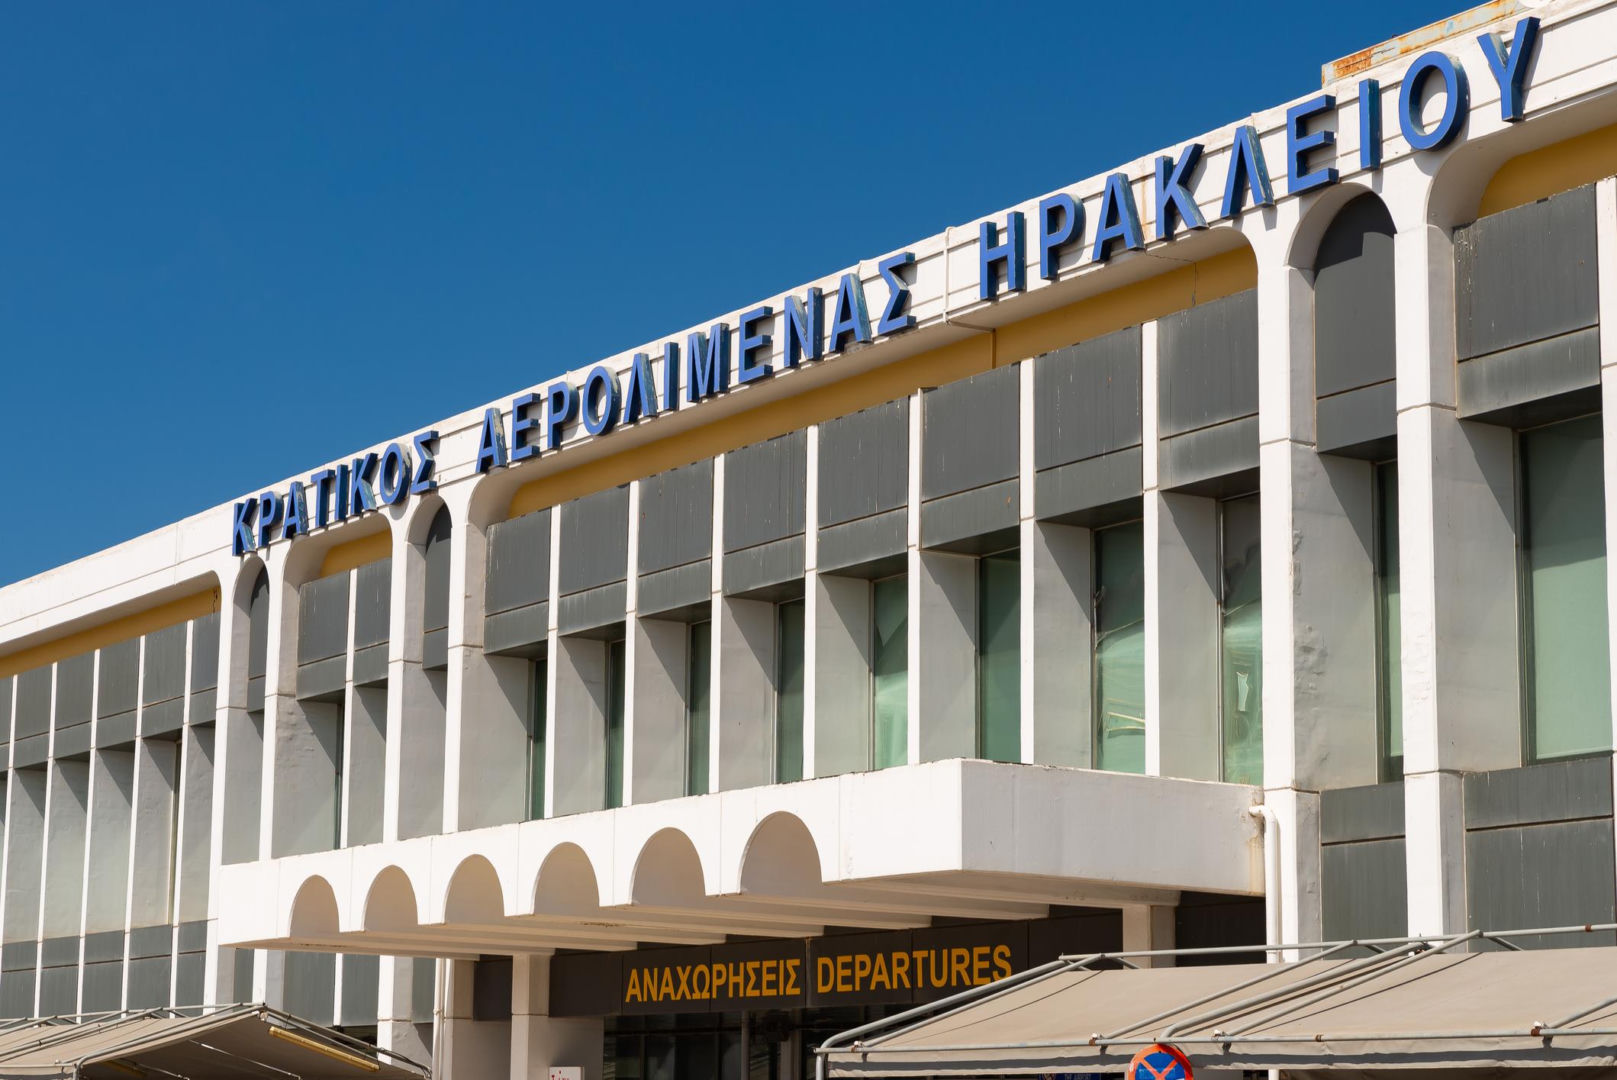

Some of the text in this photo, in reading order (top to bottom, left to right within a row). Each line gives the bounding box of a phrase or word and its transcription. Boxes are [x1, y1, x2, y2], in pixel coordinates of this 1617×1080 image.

[232, 16, 1542, 557] ΚΡΑΤΙΚΟΣ ΑΕΡΟΛΙΜΕΝΑΣ ΗΡΑΚΛΕΙΟΥ
[625, 959, 800, 1002] ΑΝΑΧΩΡΗΣΕΙΣ
[817, 945, 1012, 993] DEPARTURES
